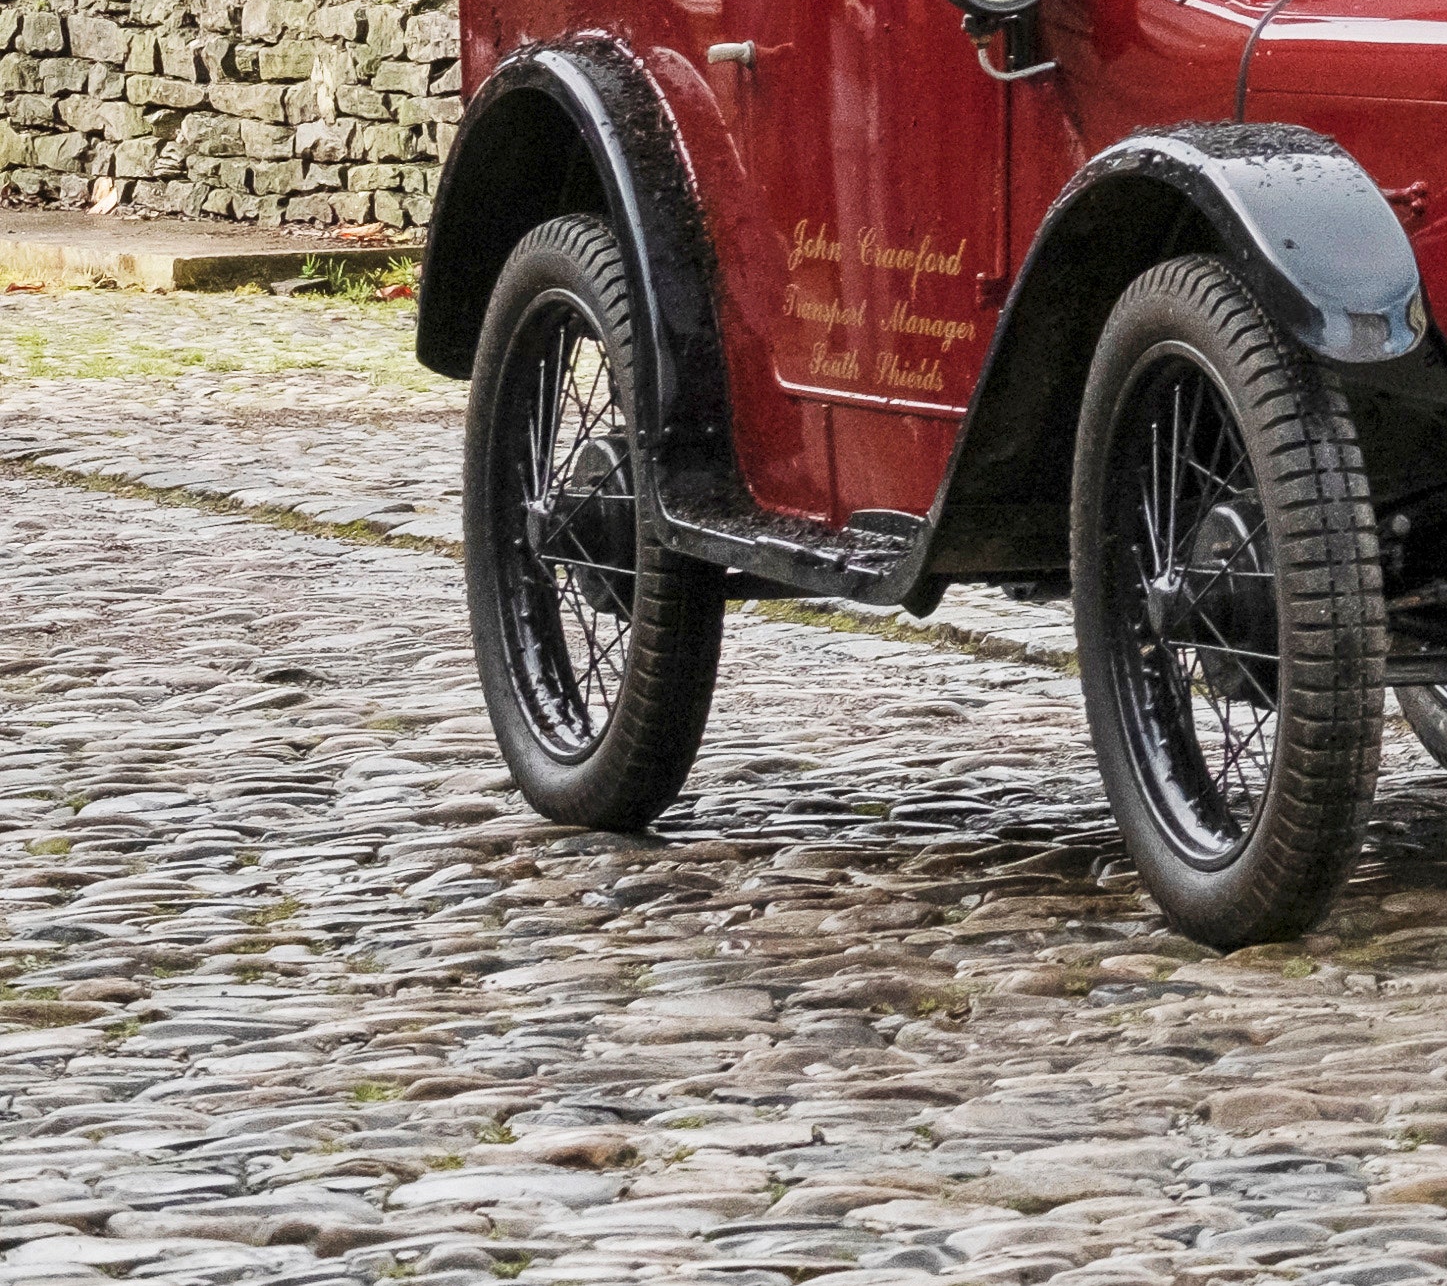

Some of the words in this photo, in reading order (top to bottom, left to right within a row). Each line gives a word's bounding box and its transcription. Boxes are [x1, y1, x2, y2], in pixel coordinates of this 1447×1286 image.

[787, 218, 842, 272] John
[858, 226, 967, 297] Crawford
[782, 283, 867, 333] Transport
[879, 299, 976, 353] Manager
[809, 340, 859, 380] South
